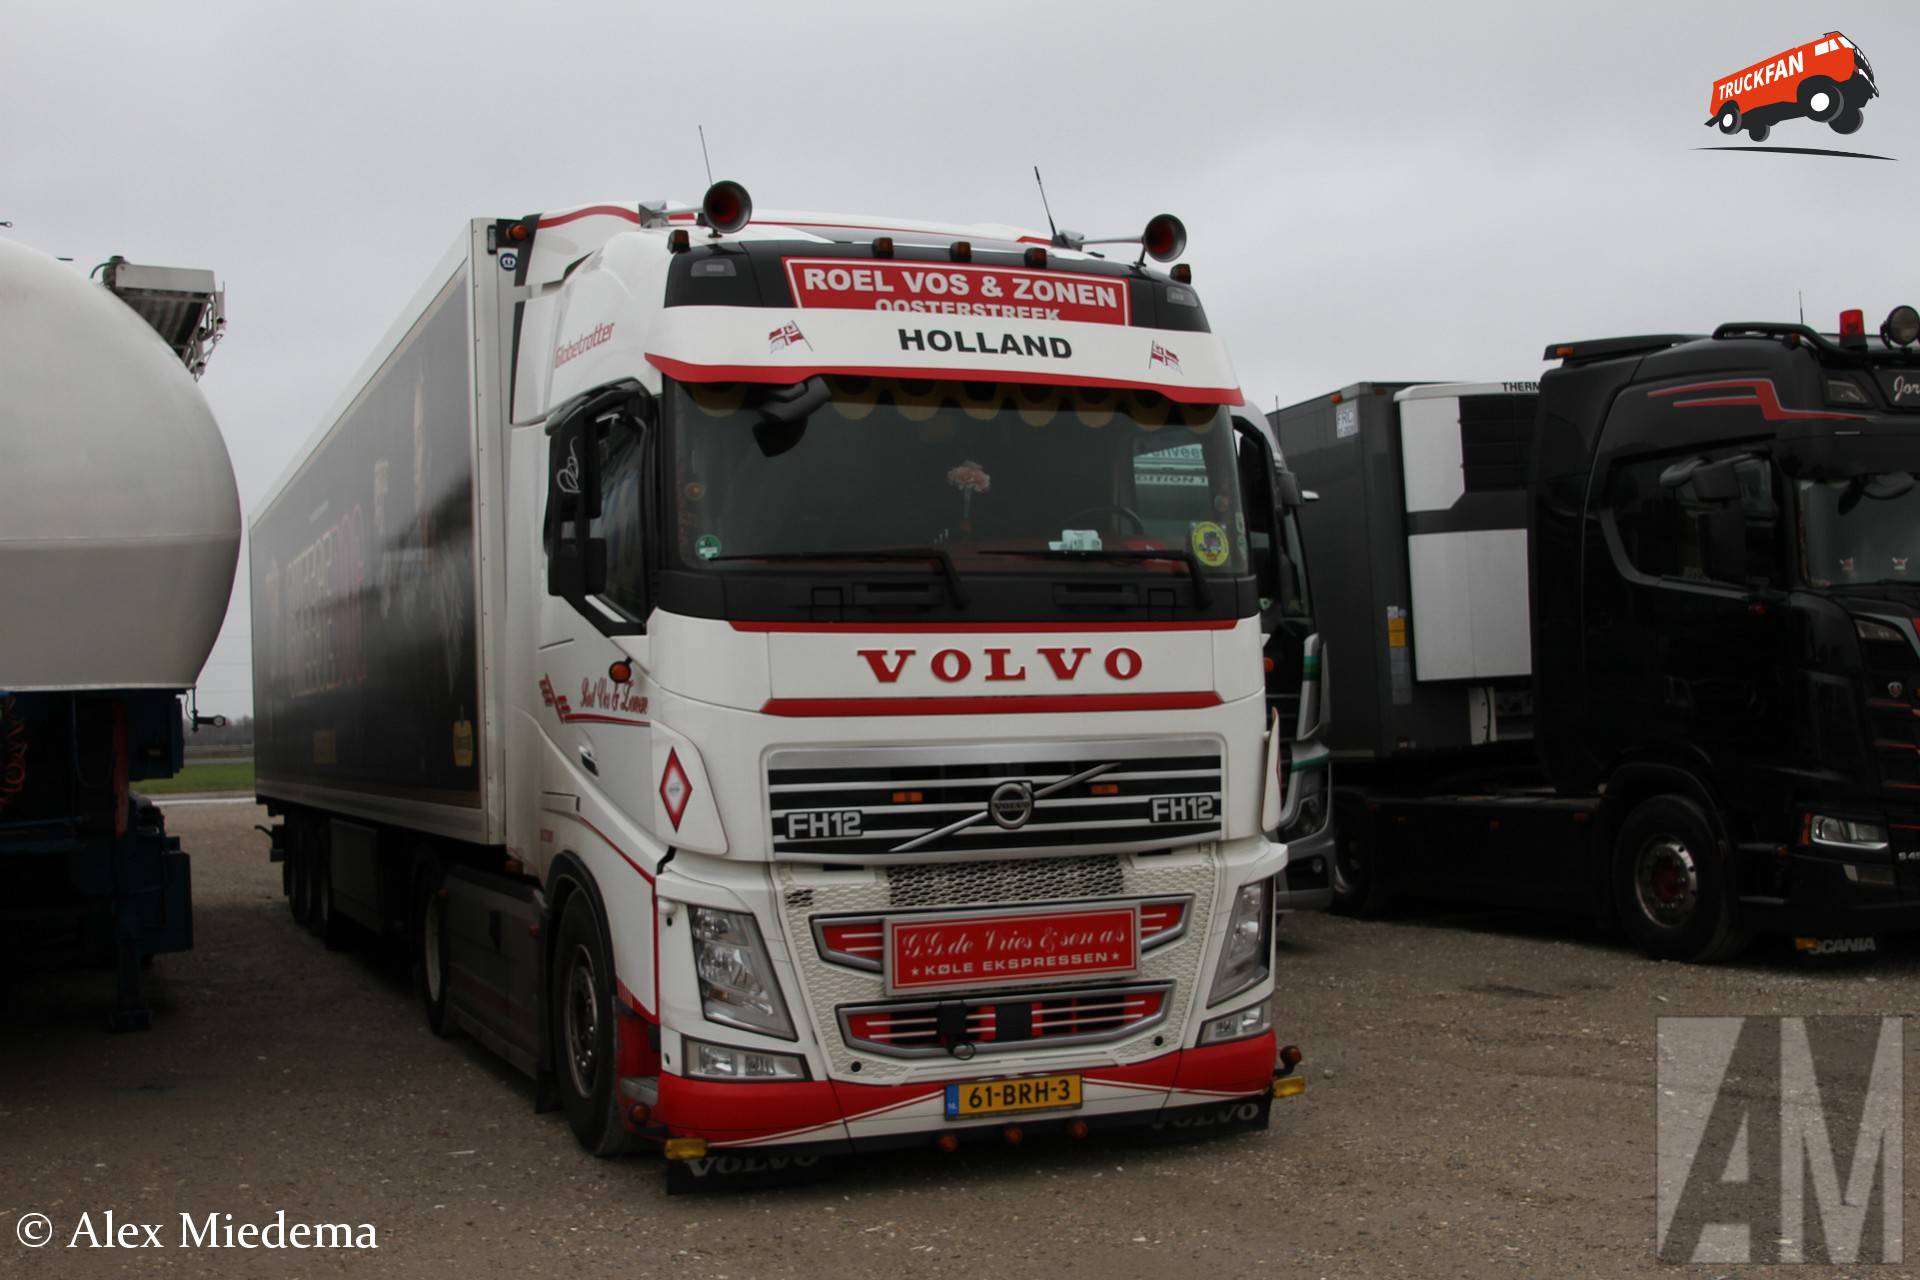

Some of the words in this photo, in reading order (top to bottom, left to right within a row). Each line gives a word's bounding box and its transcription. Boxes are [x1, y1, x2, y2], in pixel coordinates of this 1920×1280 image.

[803, 268, 894, 292] ROEL
[901, 271, 970, 296] VOS
[981, 275, 1004, 297] &
[1012, 278, 1117, 308] ZONEN
[875, 298, 1060, 321] OOSTERSTREEK
[554, 322, 615, 368] Globetrotter
[898, 328, 1072, 359] HOLLAND
[857, 647, 1142, 683] VOLVO
[1152, 796, 1213, 822] FH12
[788, 811, 861, 838] FH12
[925, 962, 974, 976] KØLE
[983, 952, 1108, 972] EKSPRESSEN
[969, 1079, 1070, 1108] 61-BRH-3
[1152, 1103, 1260, 1129] LVO
